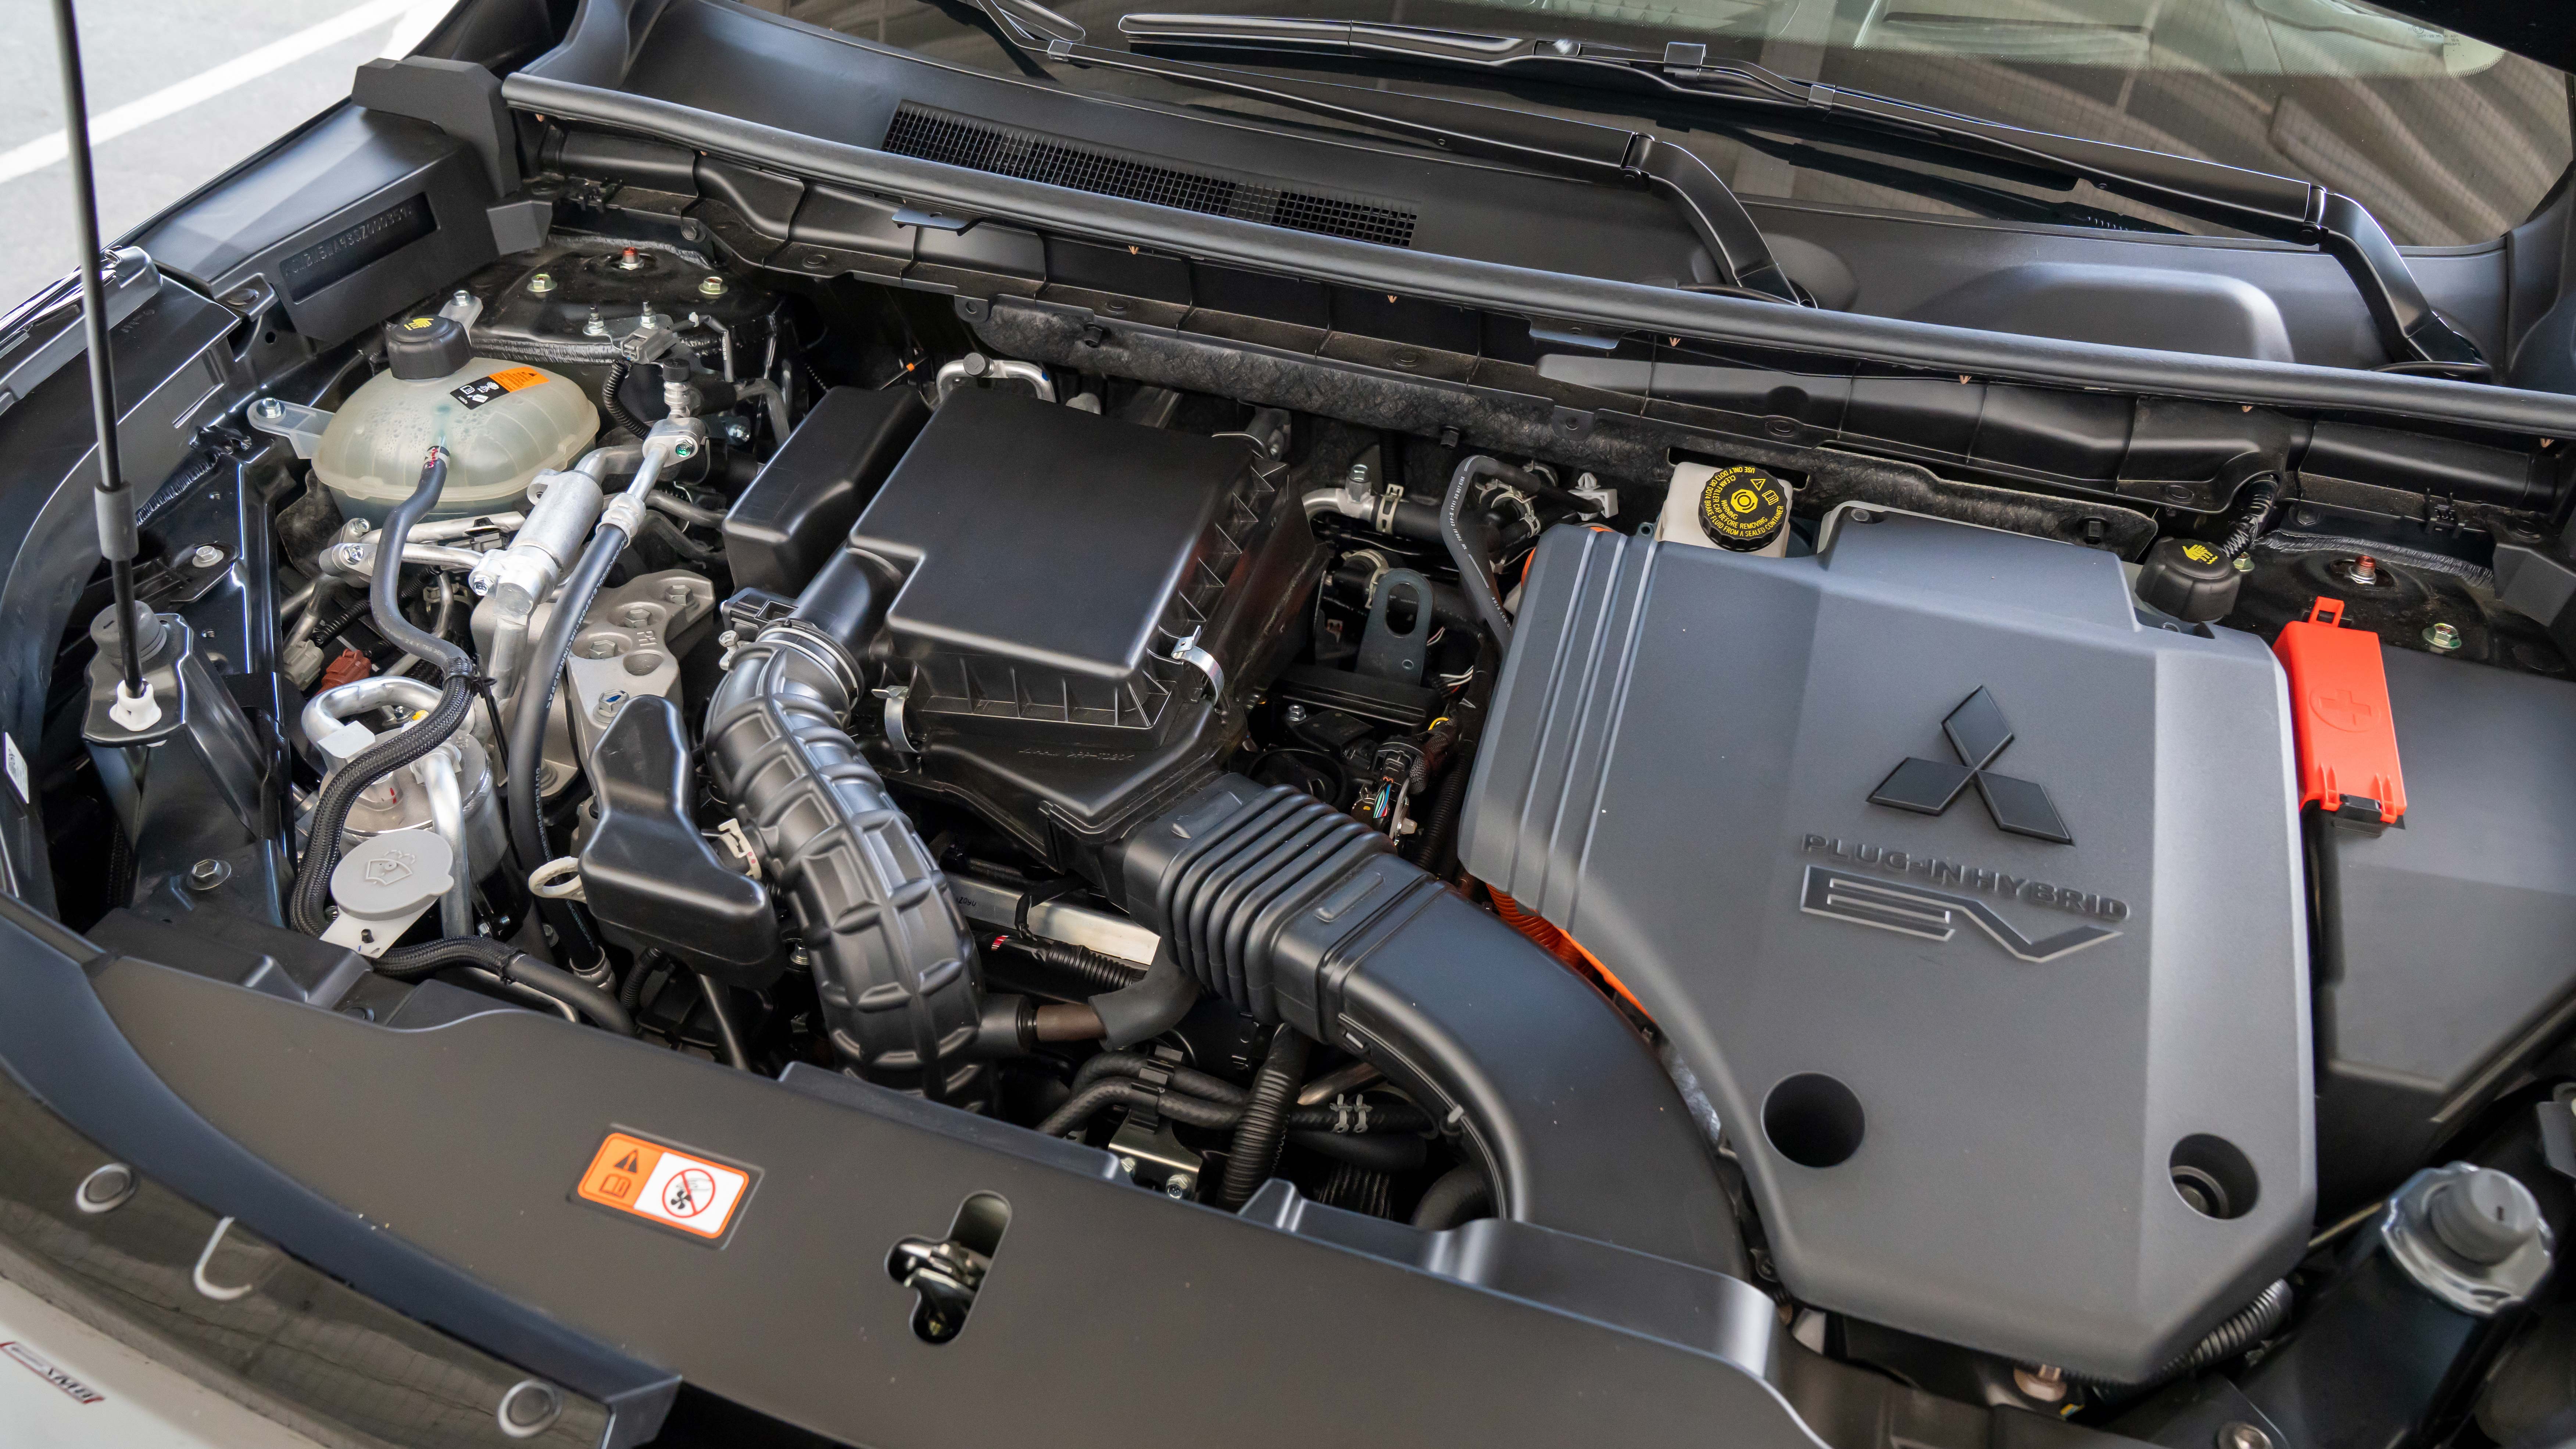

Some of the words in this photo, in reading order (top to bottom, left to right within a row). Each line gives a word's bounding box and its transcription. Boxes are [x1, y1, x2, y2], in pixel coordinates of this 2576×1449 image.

[1715, 471, 1729, 481] DOT3
[1719, 475, 1736, 487] CLEAN
[1705, 486, 1714, 499] DOT4
[1713, 486, 1722, 502] FILLER
[1704, 500, 1714, 516] BRAKE
[1713, 504, 1722, 513] CAP
[1721, 500, 1738, 520] WARNING
[1710, 515, 1724, 528] FLUID
[1718, 513, 1738, 528] BEFORE
[1740, 517, 1768, 529] REMOVING
[1765, 505, 1784, 530] CONTAINER
[1453, 529, 1463, 541] TOKAI
[1723, 526, 1739, 536] FROM
[1745, 527, 1765, 537] SEALED
[1491, 596, 1501, 610] KINK
[1499, 612, 1508, 623] NOT
[1966, 868, 2132, 923] HYBRID
